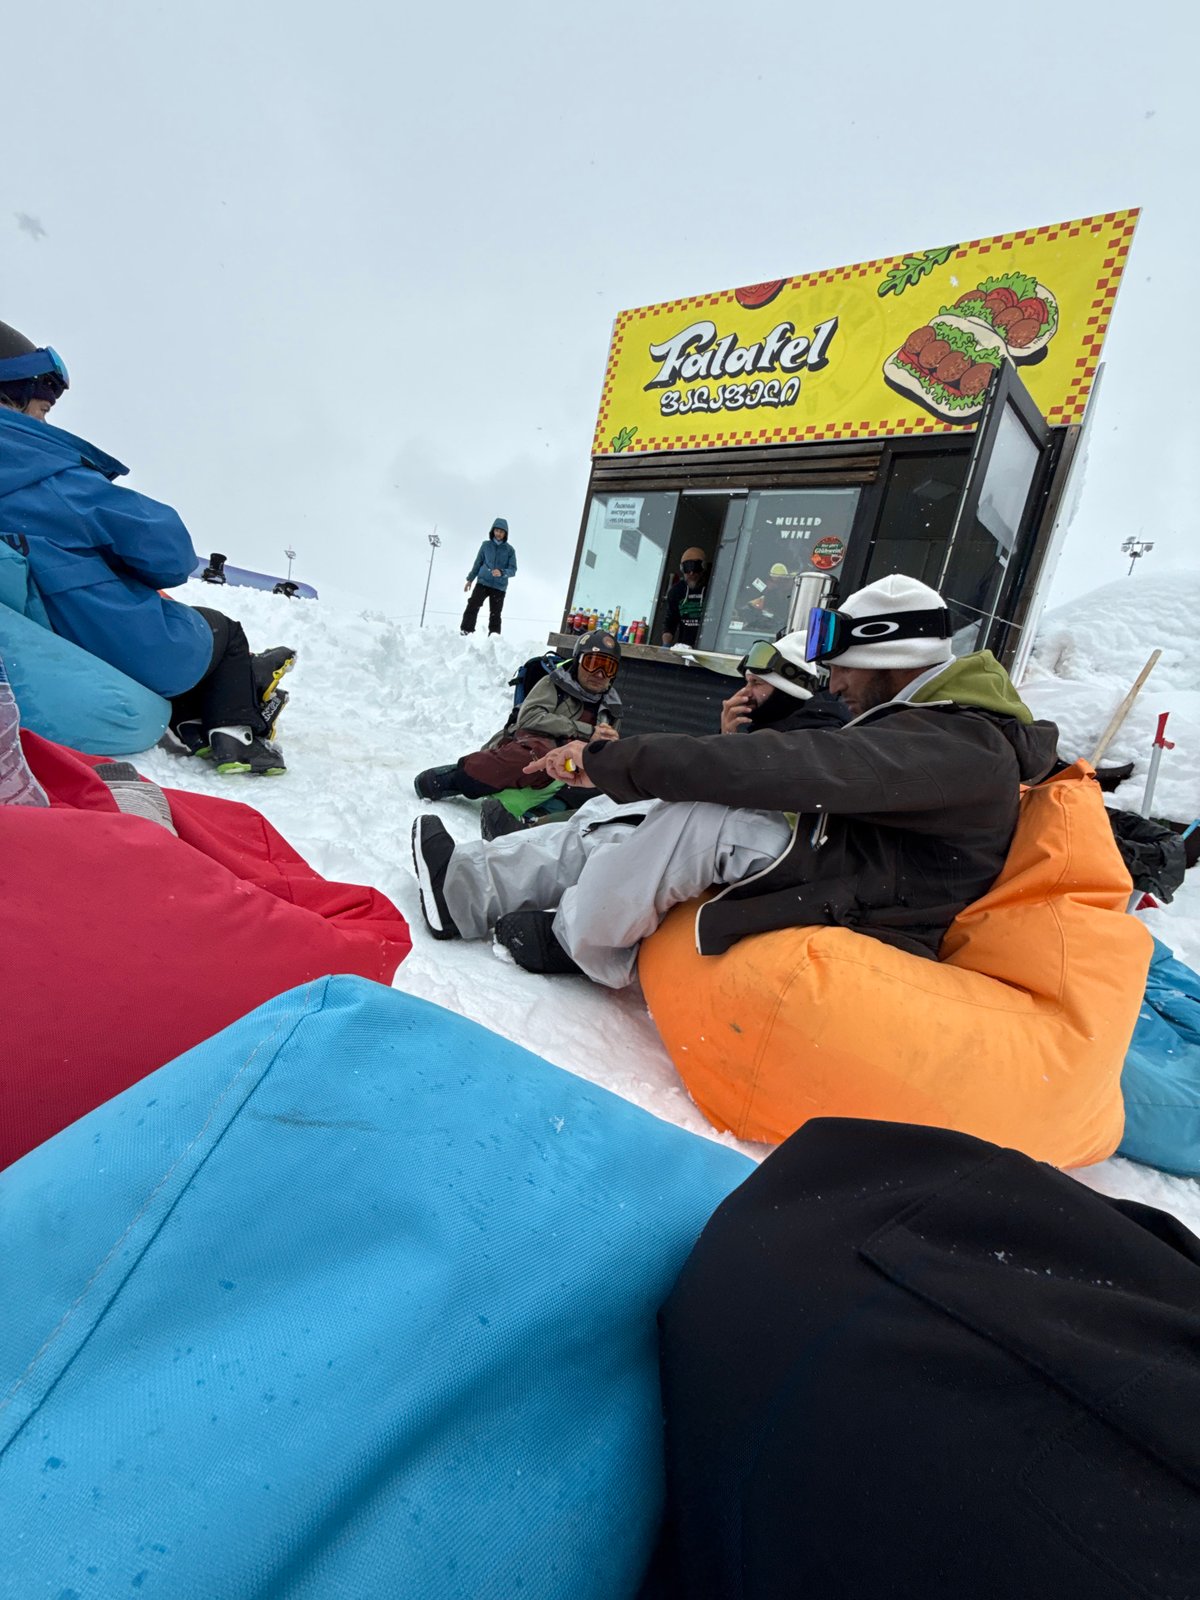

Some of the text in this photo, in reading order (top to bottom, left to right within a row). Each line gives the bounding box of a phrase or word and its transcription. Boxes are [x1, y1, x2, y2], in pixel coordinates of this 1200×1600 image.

[645, 316, 838, 390] Falafel
[660, 376, 800, 416] ფალაფელი
[776, 517, 822, 526] MULLED
[780, 530, 811, 540] WINE
[261, 696, 282, 722] NGE
